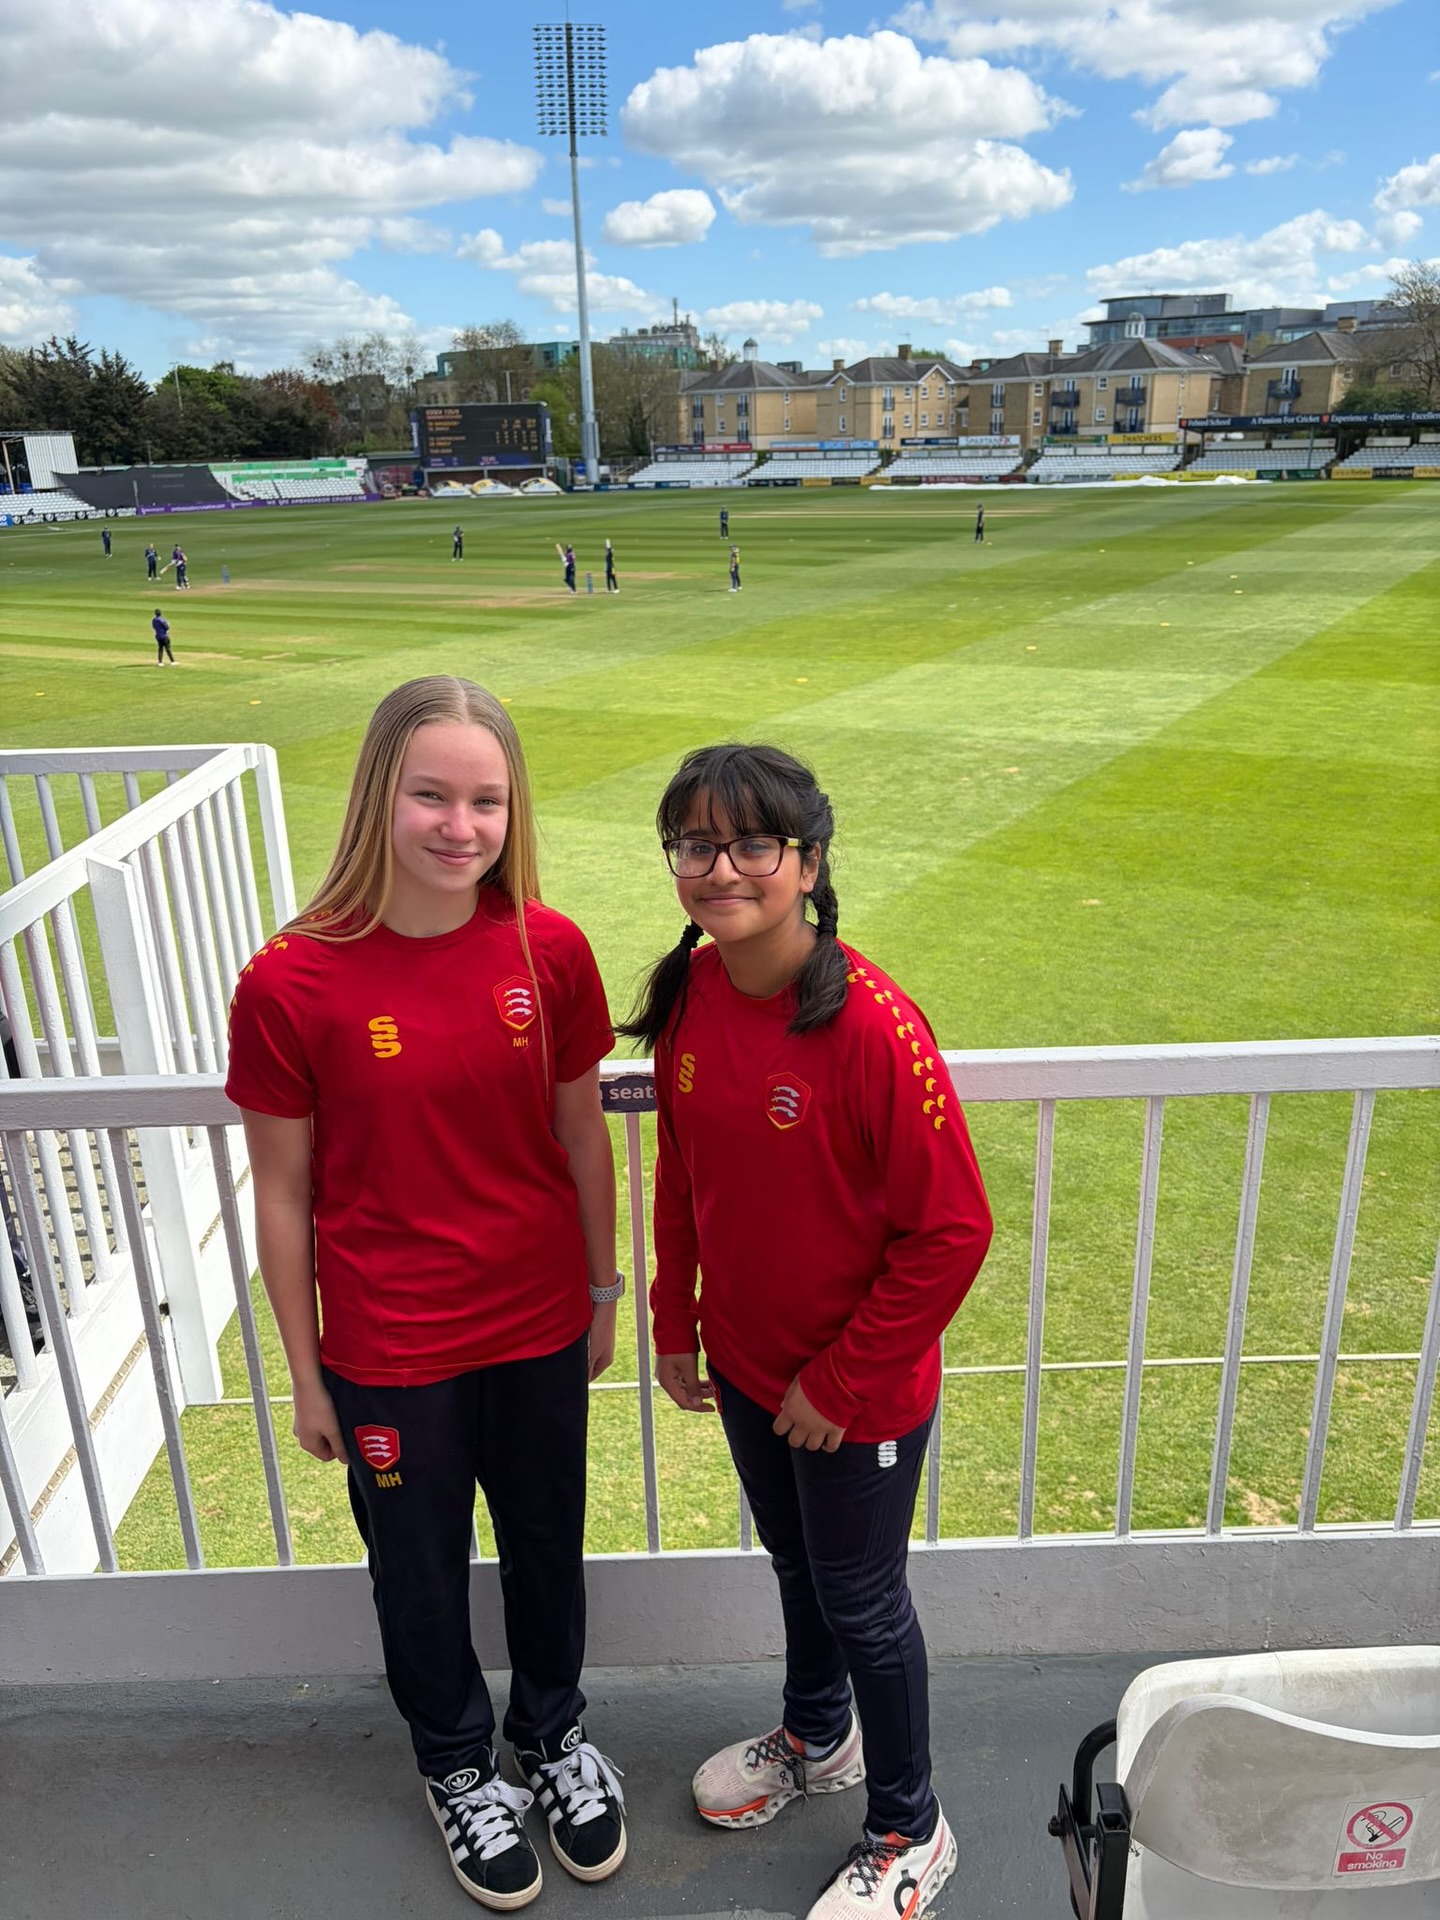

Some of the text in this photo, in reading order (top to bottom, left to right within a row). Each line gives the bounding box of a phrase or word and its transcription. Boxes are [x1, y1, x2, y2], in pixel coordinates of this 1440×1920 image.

[1210, 416, 1231, 425] School
[1259, 416, 1282, 424] Passion
[1283, 415, 1295, 423] For
[1296, 414, 1320, 423] Cricket
[1331, 415, 1368, 424] Experience
[1373, 413, 1405, 422] Expertise
[1122, 434, 1162, 442] THATCHERS
[332, 495, 352, 503] CRUISE
[512, 1036, 529, 1047] MH
[609, 1085, 658, 1100] seat
[375, 1472, 403, 1488] MH
[1365, 1852, 1383, 1860] No
[1347, 1860, 1397, 1870] smoking
